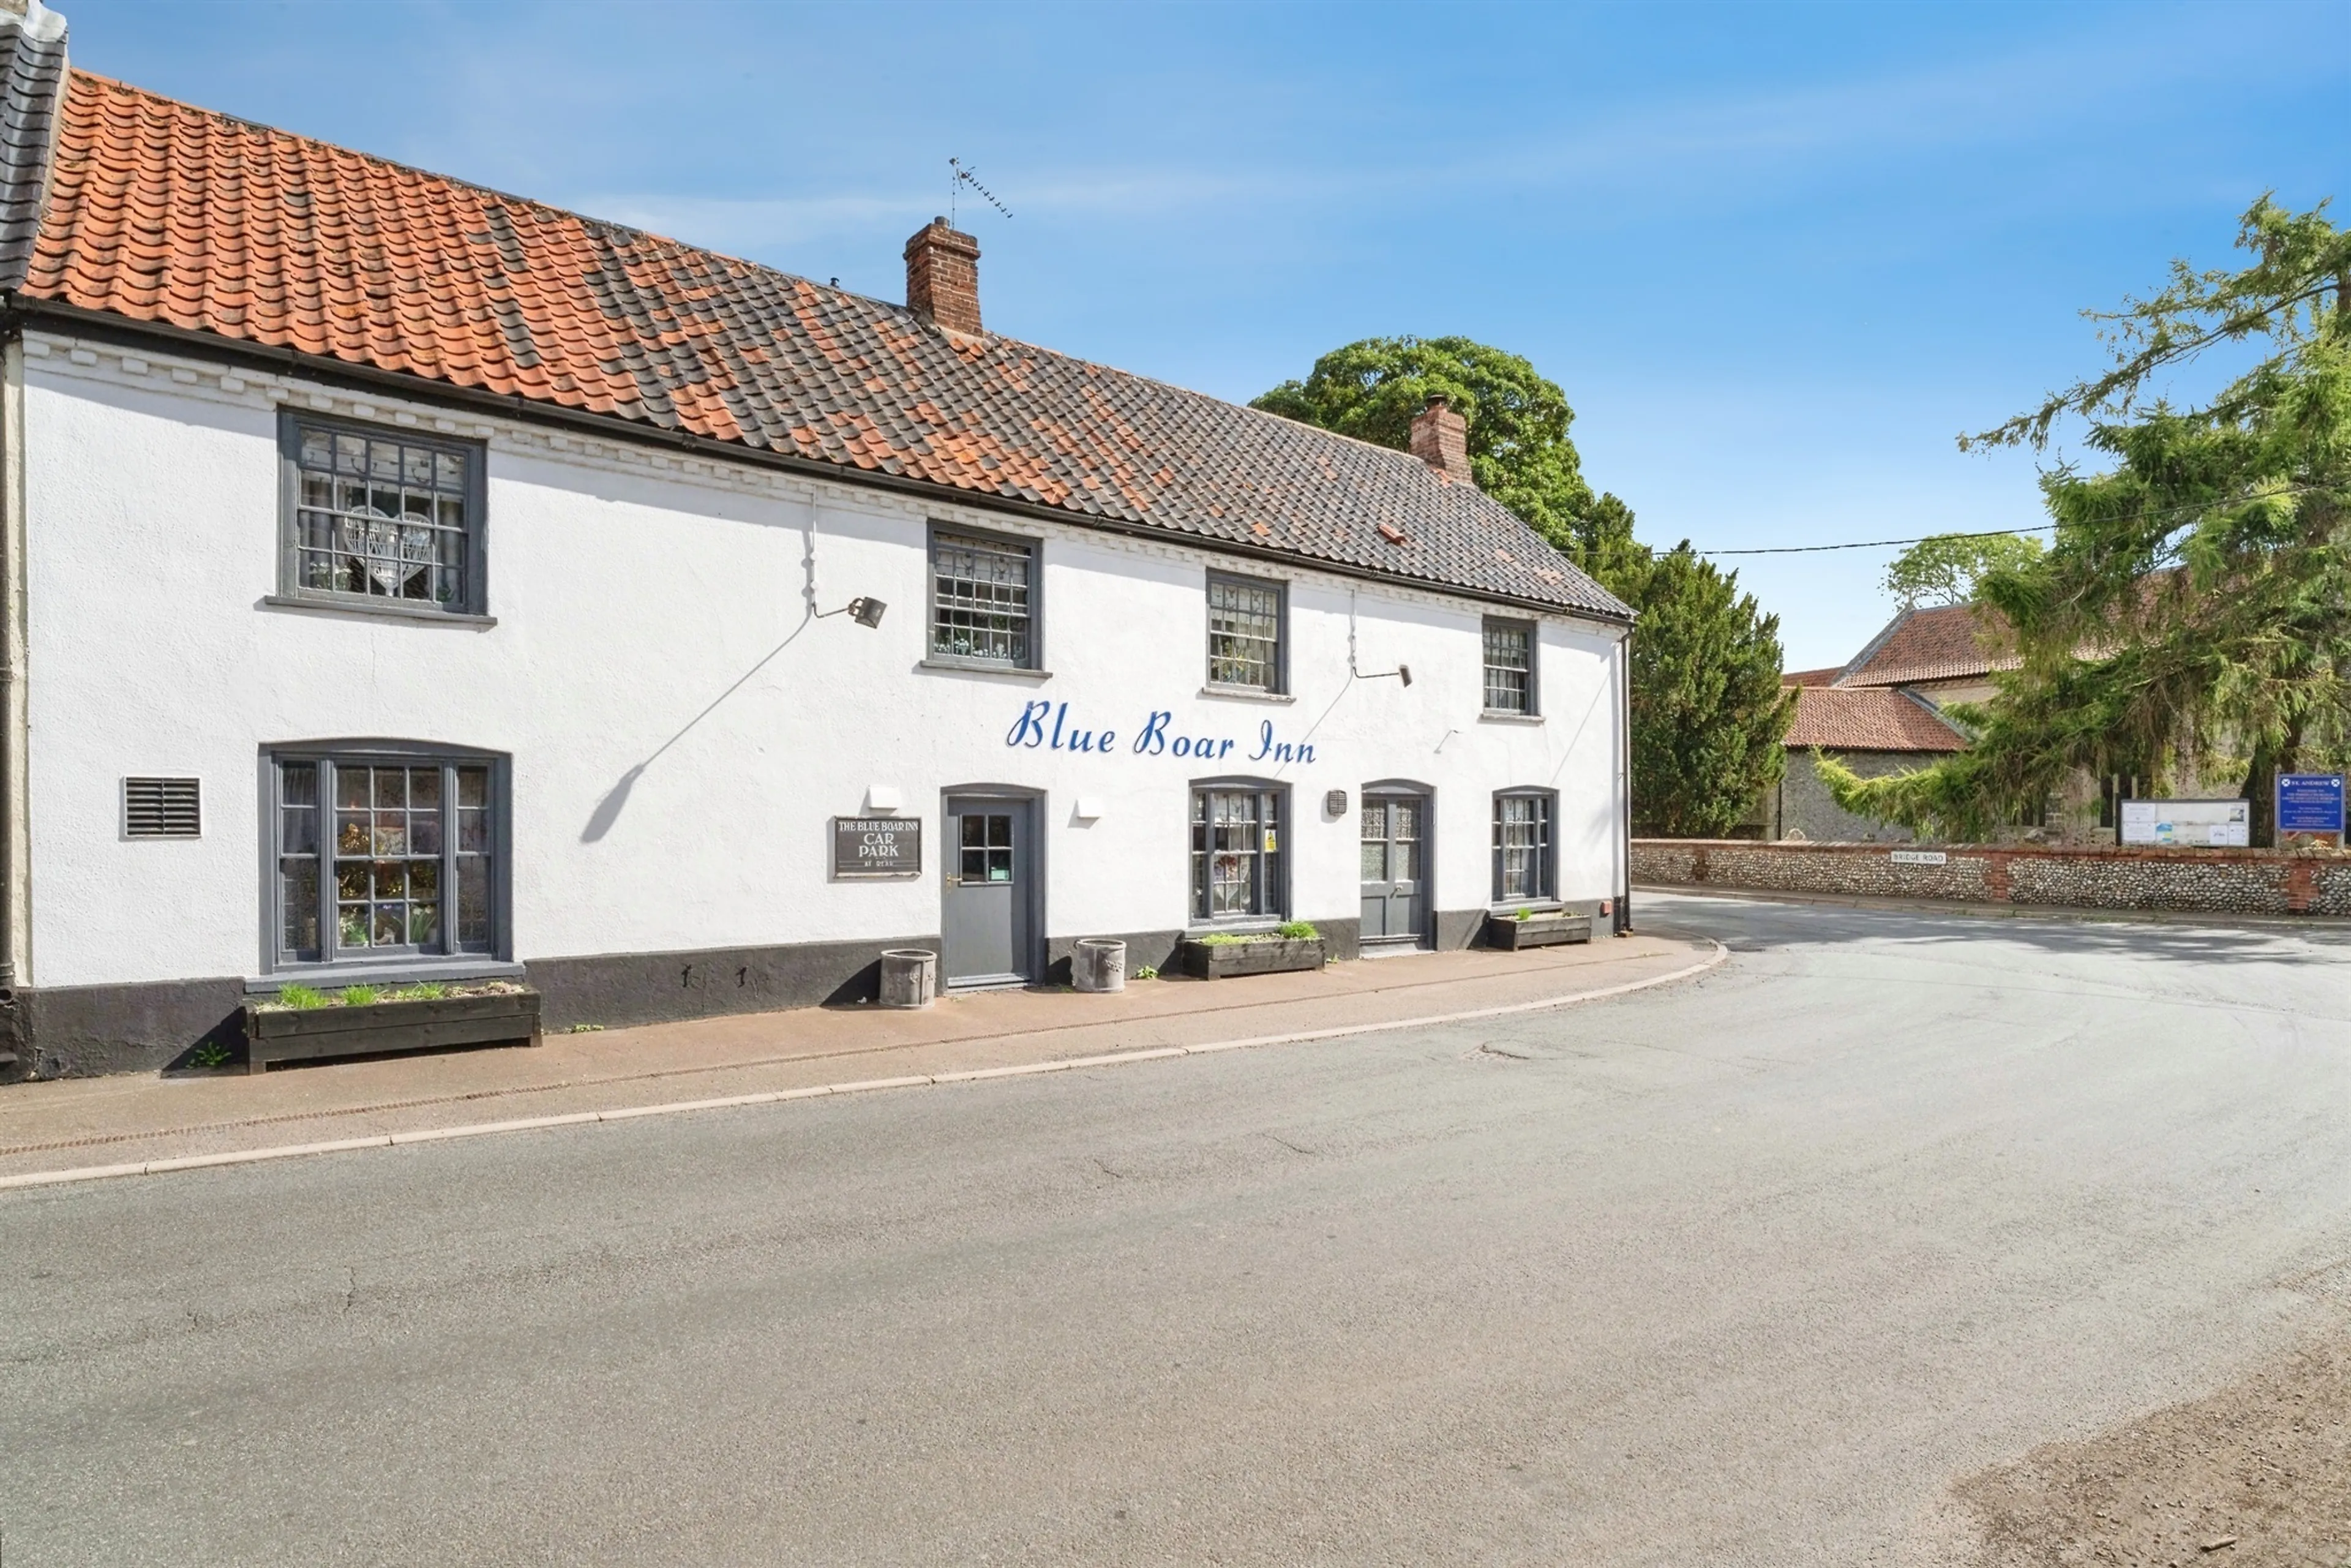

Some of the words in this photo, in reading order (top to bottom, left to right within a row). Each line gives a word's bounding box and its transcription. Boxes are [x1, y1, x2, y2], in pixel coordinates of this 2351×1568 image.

[1007, 700, 1116, 752] Blue
[1133, 711, 1234, 759] Boar
[1248, 719, 1316, 763] Inn
[838, 821, 857, 831] THE
[858, 822, 880, 831] BLUE
[882, 822, 904, 831] BOAR
[905, 822, 918, 831] INN
[864, 833, 894, 844] CAR
[859, 845, 899, 857] PARK
